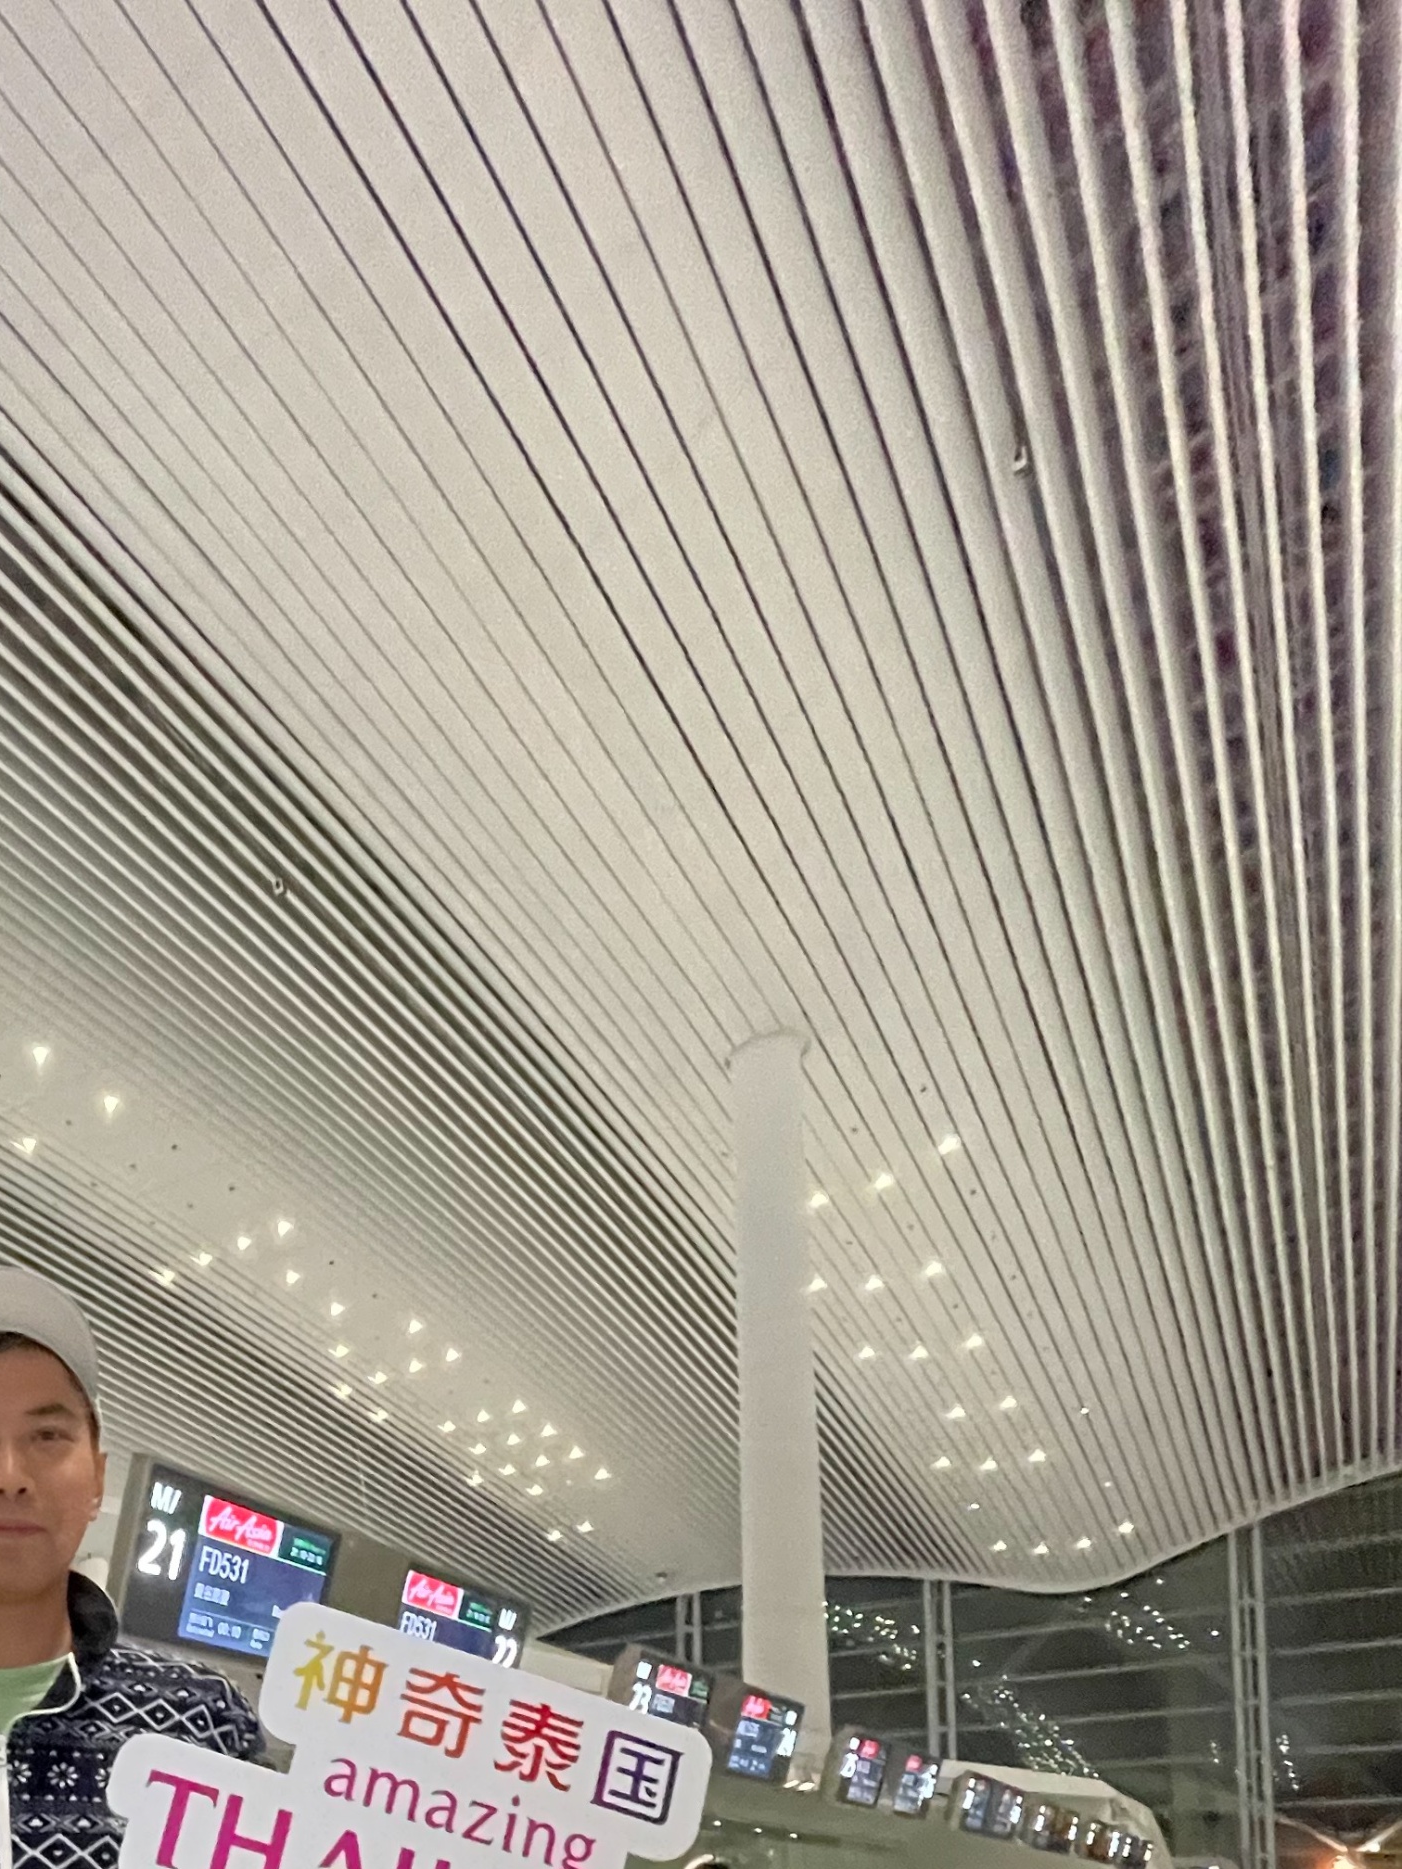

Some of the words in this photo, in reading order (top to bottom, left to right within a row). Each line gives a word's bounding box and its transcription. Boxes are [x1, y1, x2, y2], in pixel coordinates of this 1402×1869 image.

[137, 1519, 187, 1581] 21
[199, 1545, 250, 1585] FD531
[293, 1631, 689, 1827] 神奇泰国
